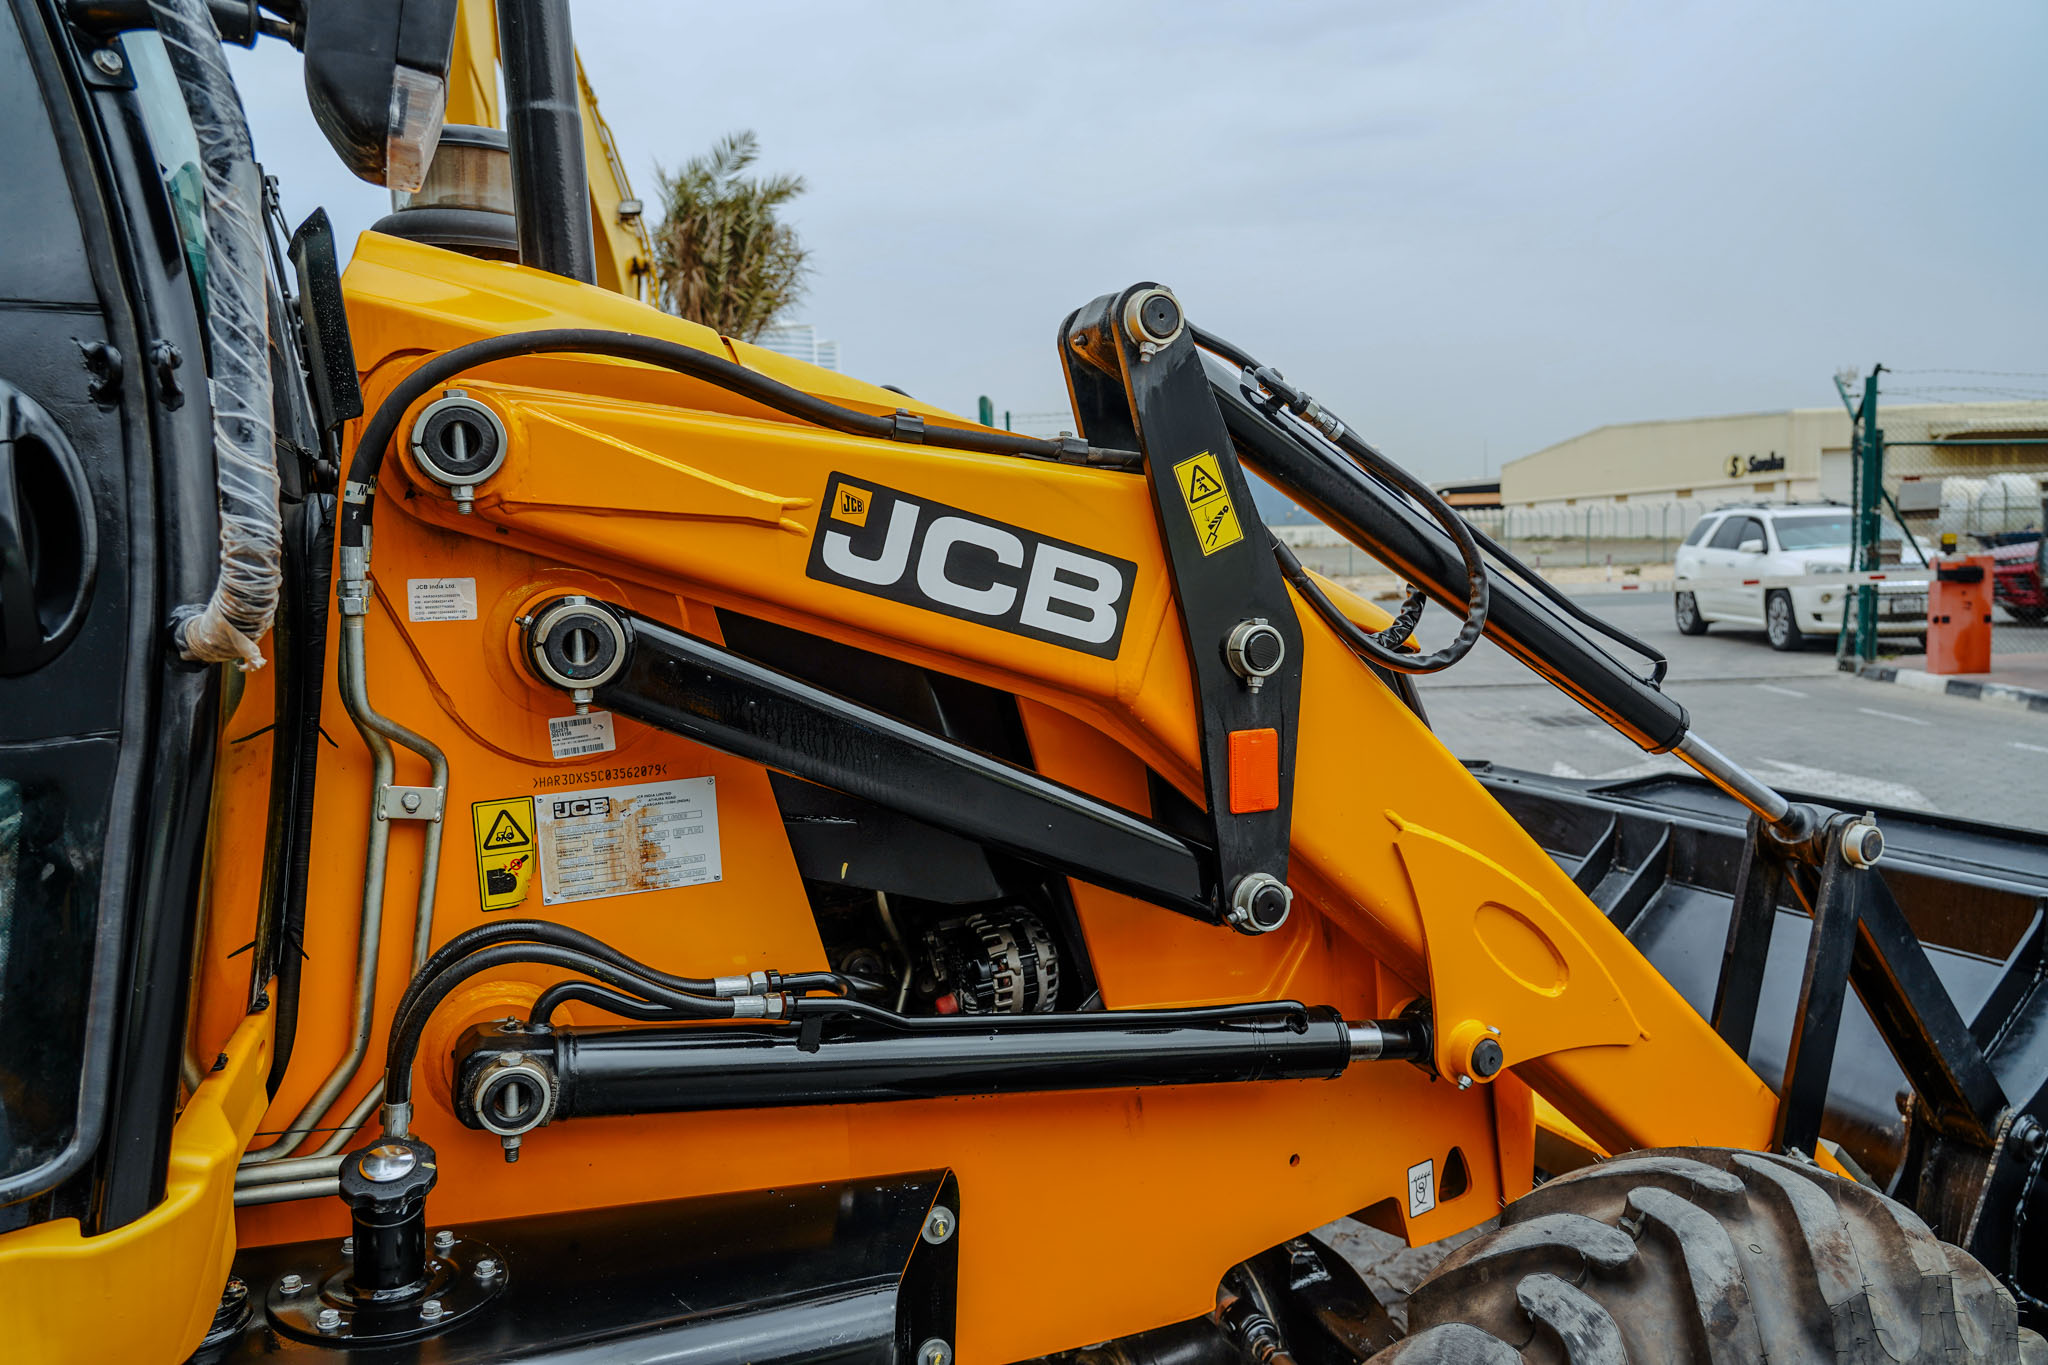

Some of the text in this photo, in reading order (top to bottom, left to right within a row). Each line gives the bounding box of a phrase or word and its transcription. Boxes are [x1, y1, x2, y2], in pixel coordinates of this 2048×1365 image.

[844, 494, 863, 512] JCB
[822, 499, 1123, 644] JCB
[555, 798, 609, 818] JCB
